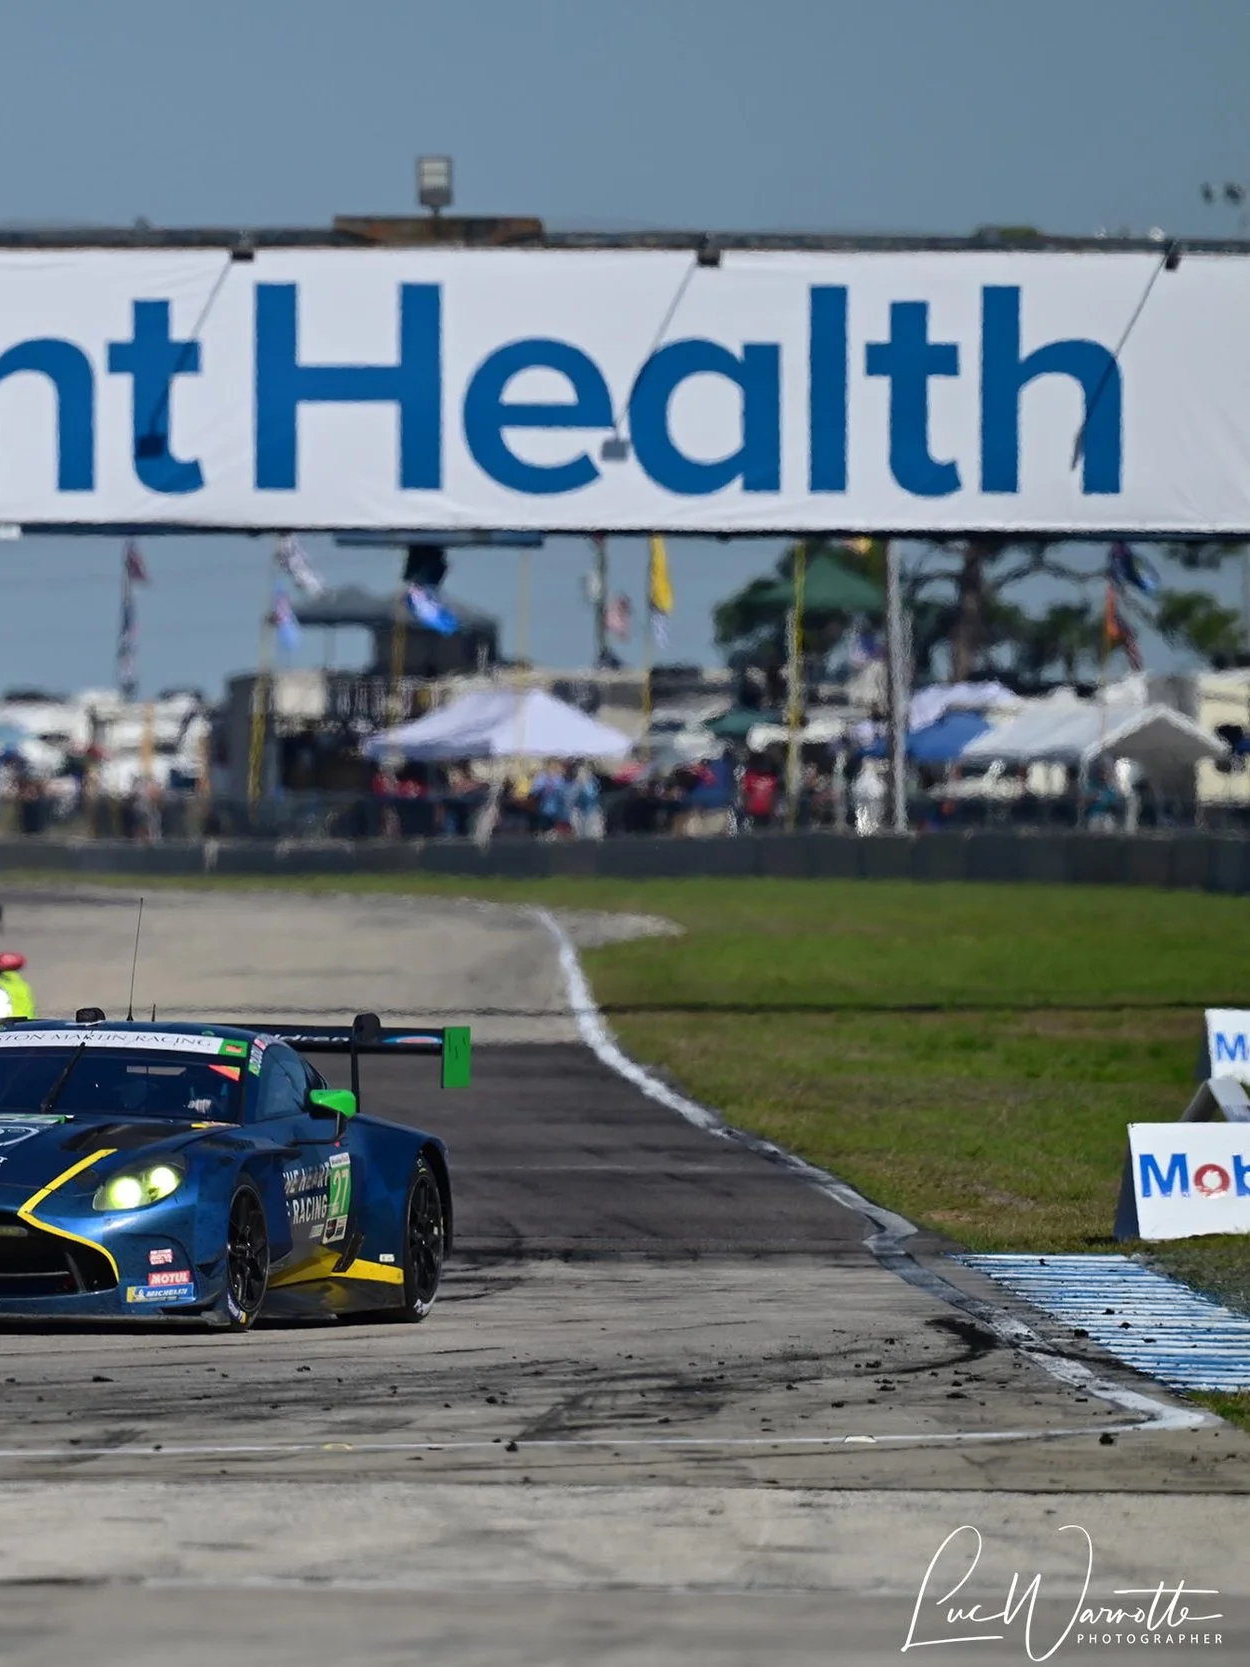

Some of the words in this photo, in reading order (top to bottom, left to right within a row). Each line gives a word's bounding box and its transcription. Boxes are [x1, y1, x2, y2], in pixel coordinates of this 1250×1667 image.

[50, 1033, 129, 1043] MARTIN
[134, 1034, 212, 1048] RACING
[1215, 1032, 1250, 1062] M
[331, 1168, 350, 1216] 27
[292, 1194, 328, 1225] RACING
[150, 1272, 189, 1284] MOTUL
[145, 1287, 188, 1297] MICHELIN
